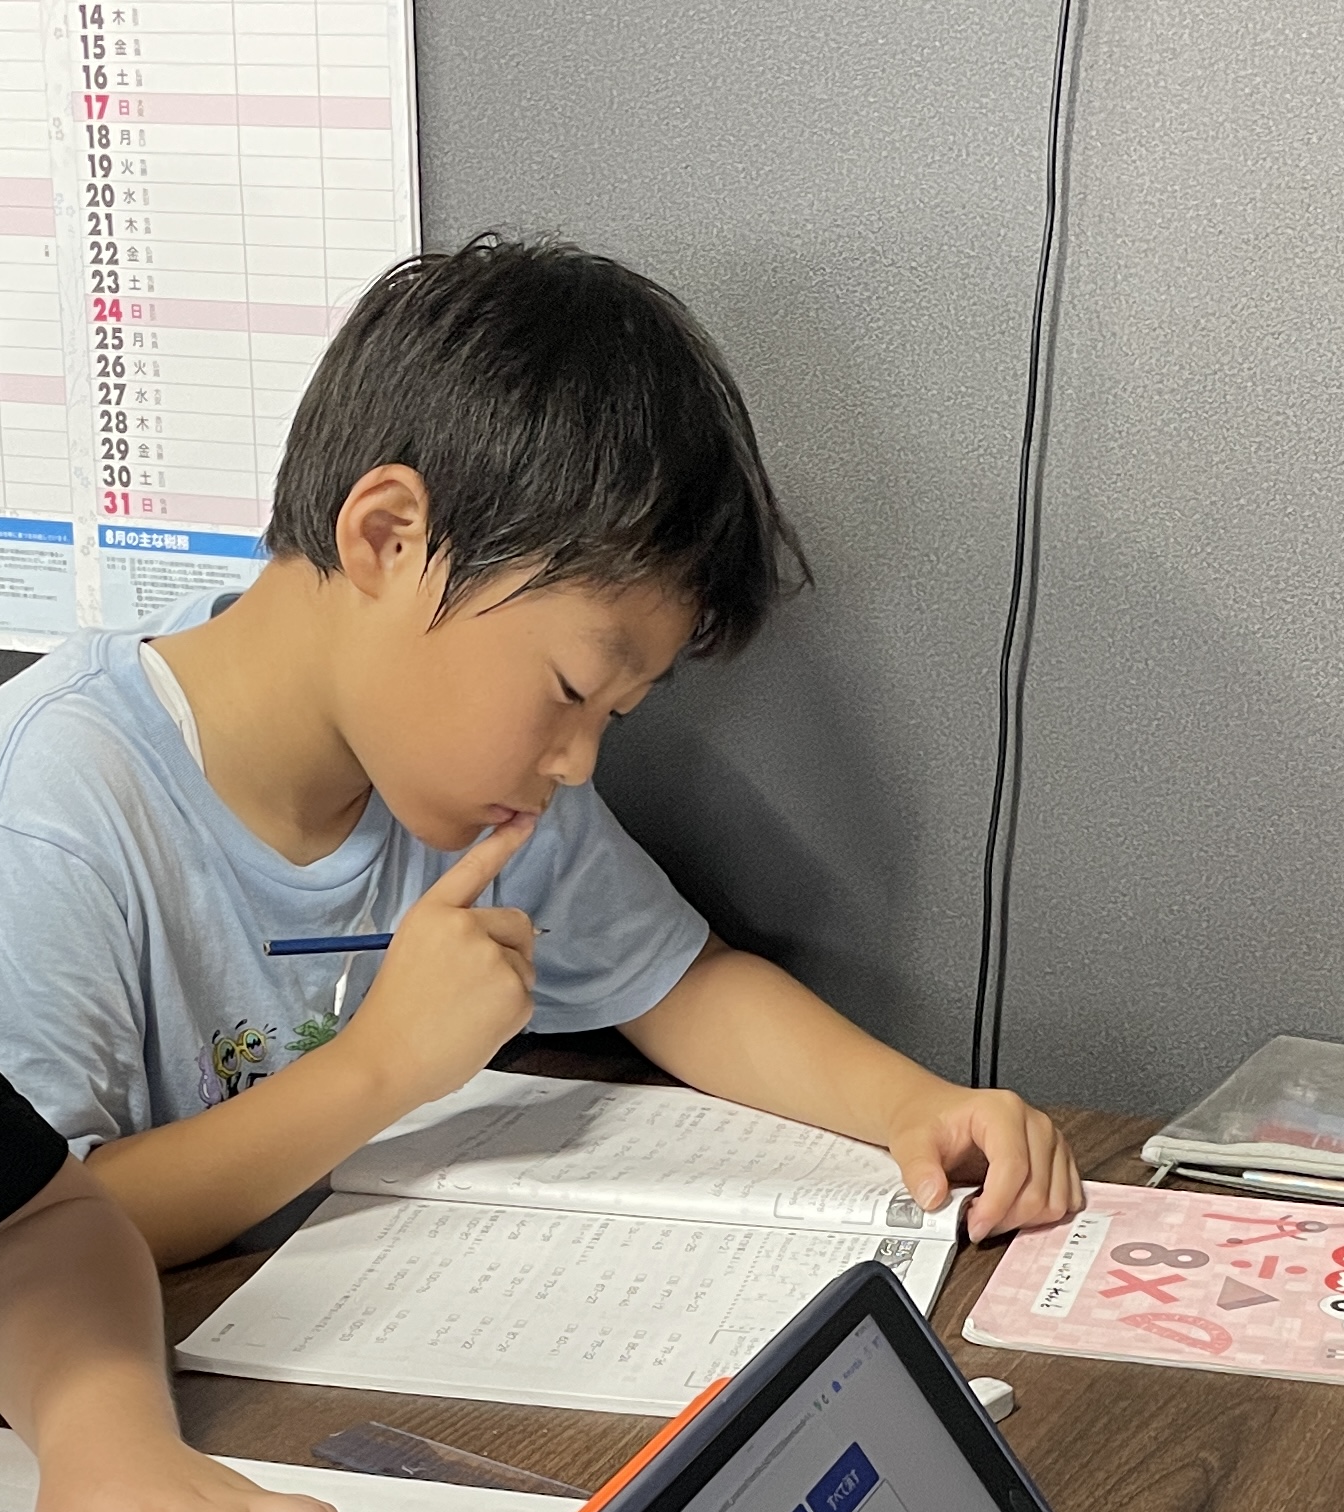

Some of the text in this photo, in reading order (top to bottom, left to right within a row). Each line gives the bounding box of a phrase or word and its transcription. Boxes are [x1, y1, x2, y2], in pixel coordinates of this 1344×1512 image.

[79, 4, 125, 29] 14 木
[80, 35, 127, 59] 15 金
[82, 65, 129, 89] 16 土
[84, 95, 129, 119] 17 日
[86, 125, 130, 149] 18 月
[88, 154, 134, 178] 19 火
[86, 183, 136, 207] 20 水
[88, 212, 138, 236] 21 木
[90, 241, 139, 265] 22 金
[92, 270, 141, 294] 23 土
[94, 298, 142, 322] 24 日
[95, 326, 143, 350] 25 月
[97, 354, 146, 378] 26 火
[98, 382, 148, 405] 27 水
[100, 410, 149, 433] 28 木
[101, 438, 150, 460] 29 金
[103, 464, 152, 488] 30 土
[104, 491, 152, 515] 31 日
[106, 529, 189, 550] 8月の主な税務
